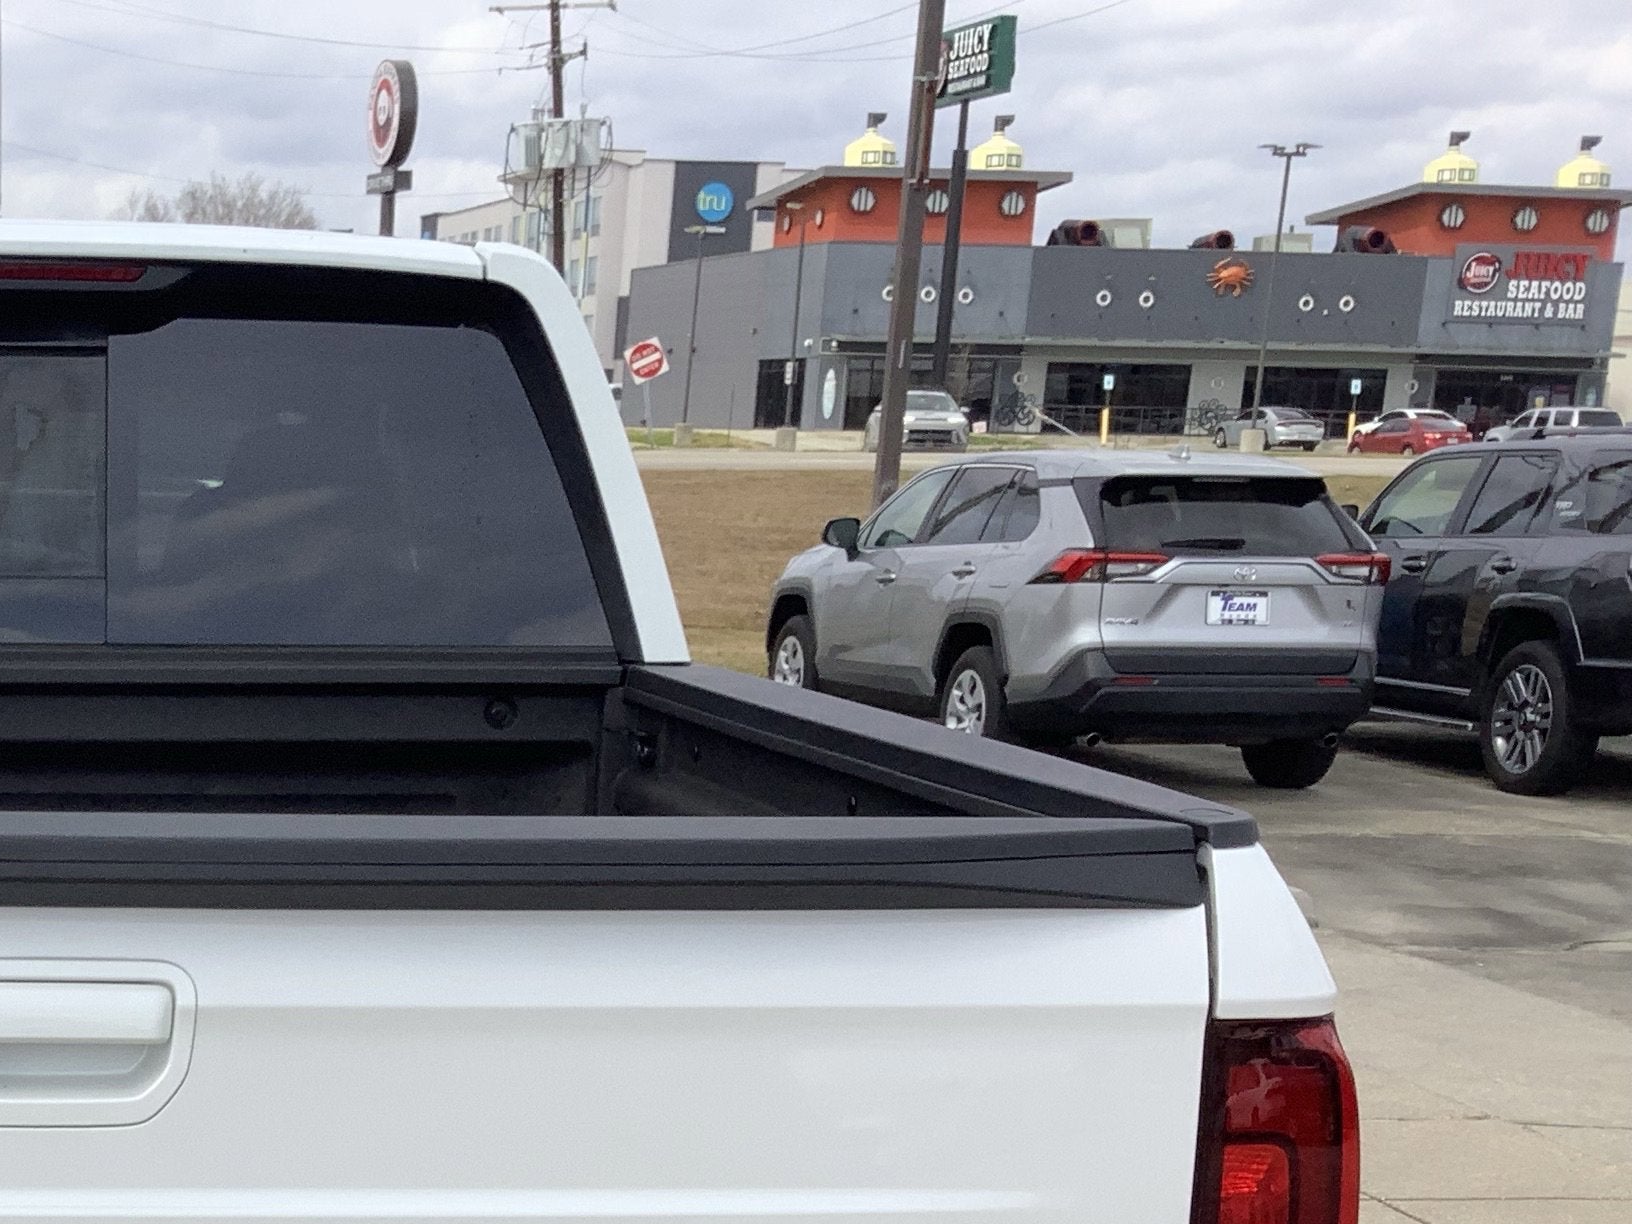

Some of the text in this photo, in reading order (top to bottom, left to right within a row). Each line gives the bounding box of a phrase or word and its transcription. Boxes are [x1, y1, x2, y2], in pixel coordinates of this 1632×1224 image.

[949, 24, 992, 60] JUICY
[948, 53, 989, 79] SEAFOOD
[698, 191, 726, 211] tru
[1506, 252, 1589, 280] JUICY
[1507, 280, 1586, 300] SEAFOOD
[1453, 300, 1585, 320] RESTAURANT & BAR
[1220, 593, 1257, 612] TEAM
